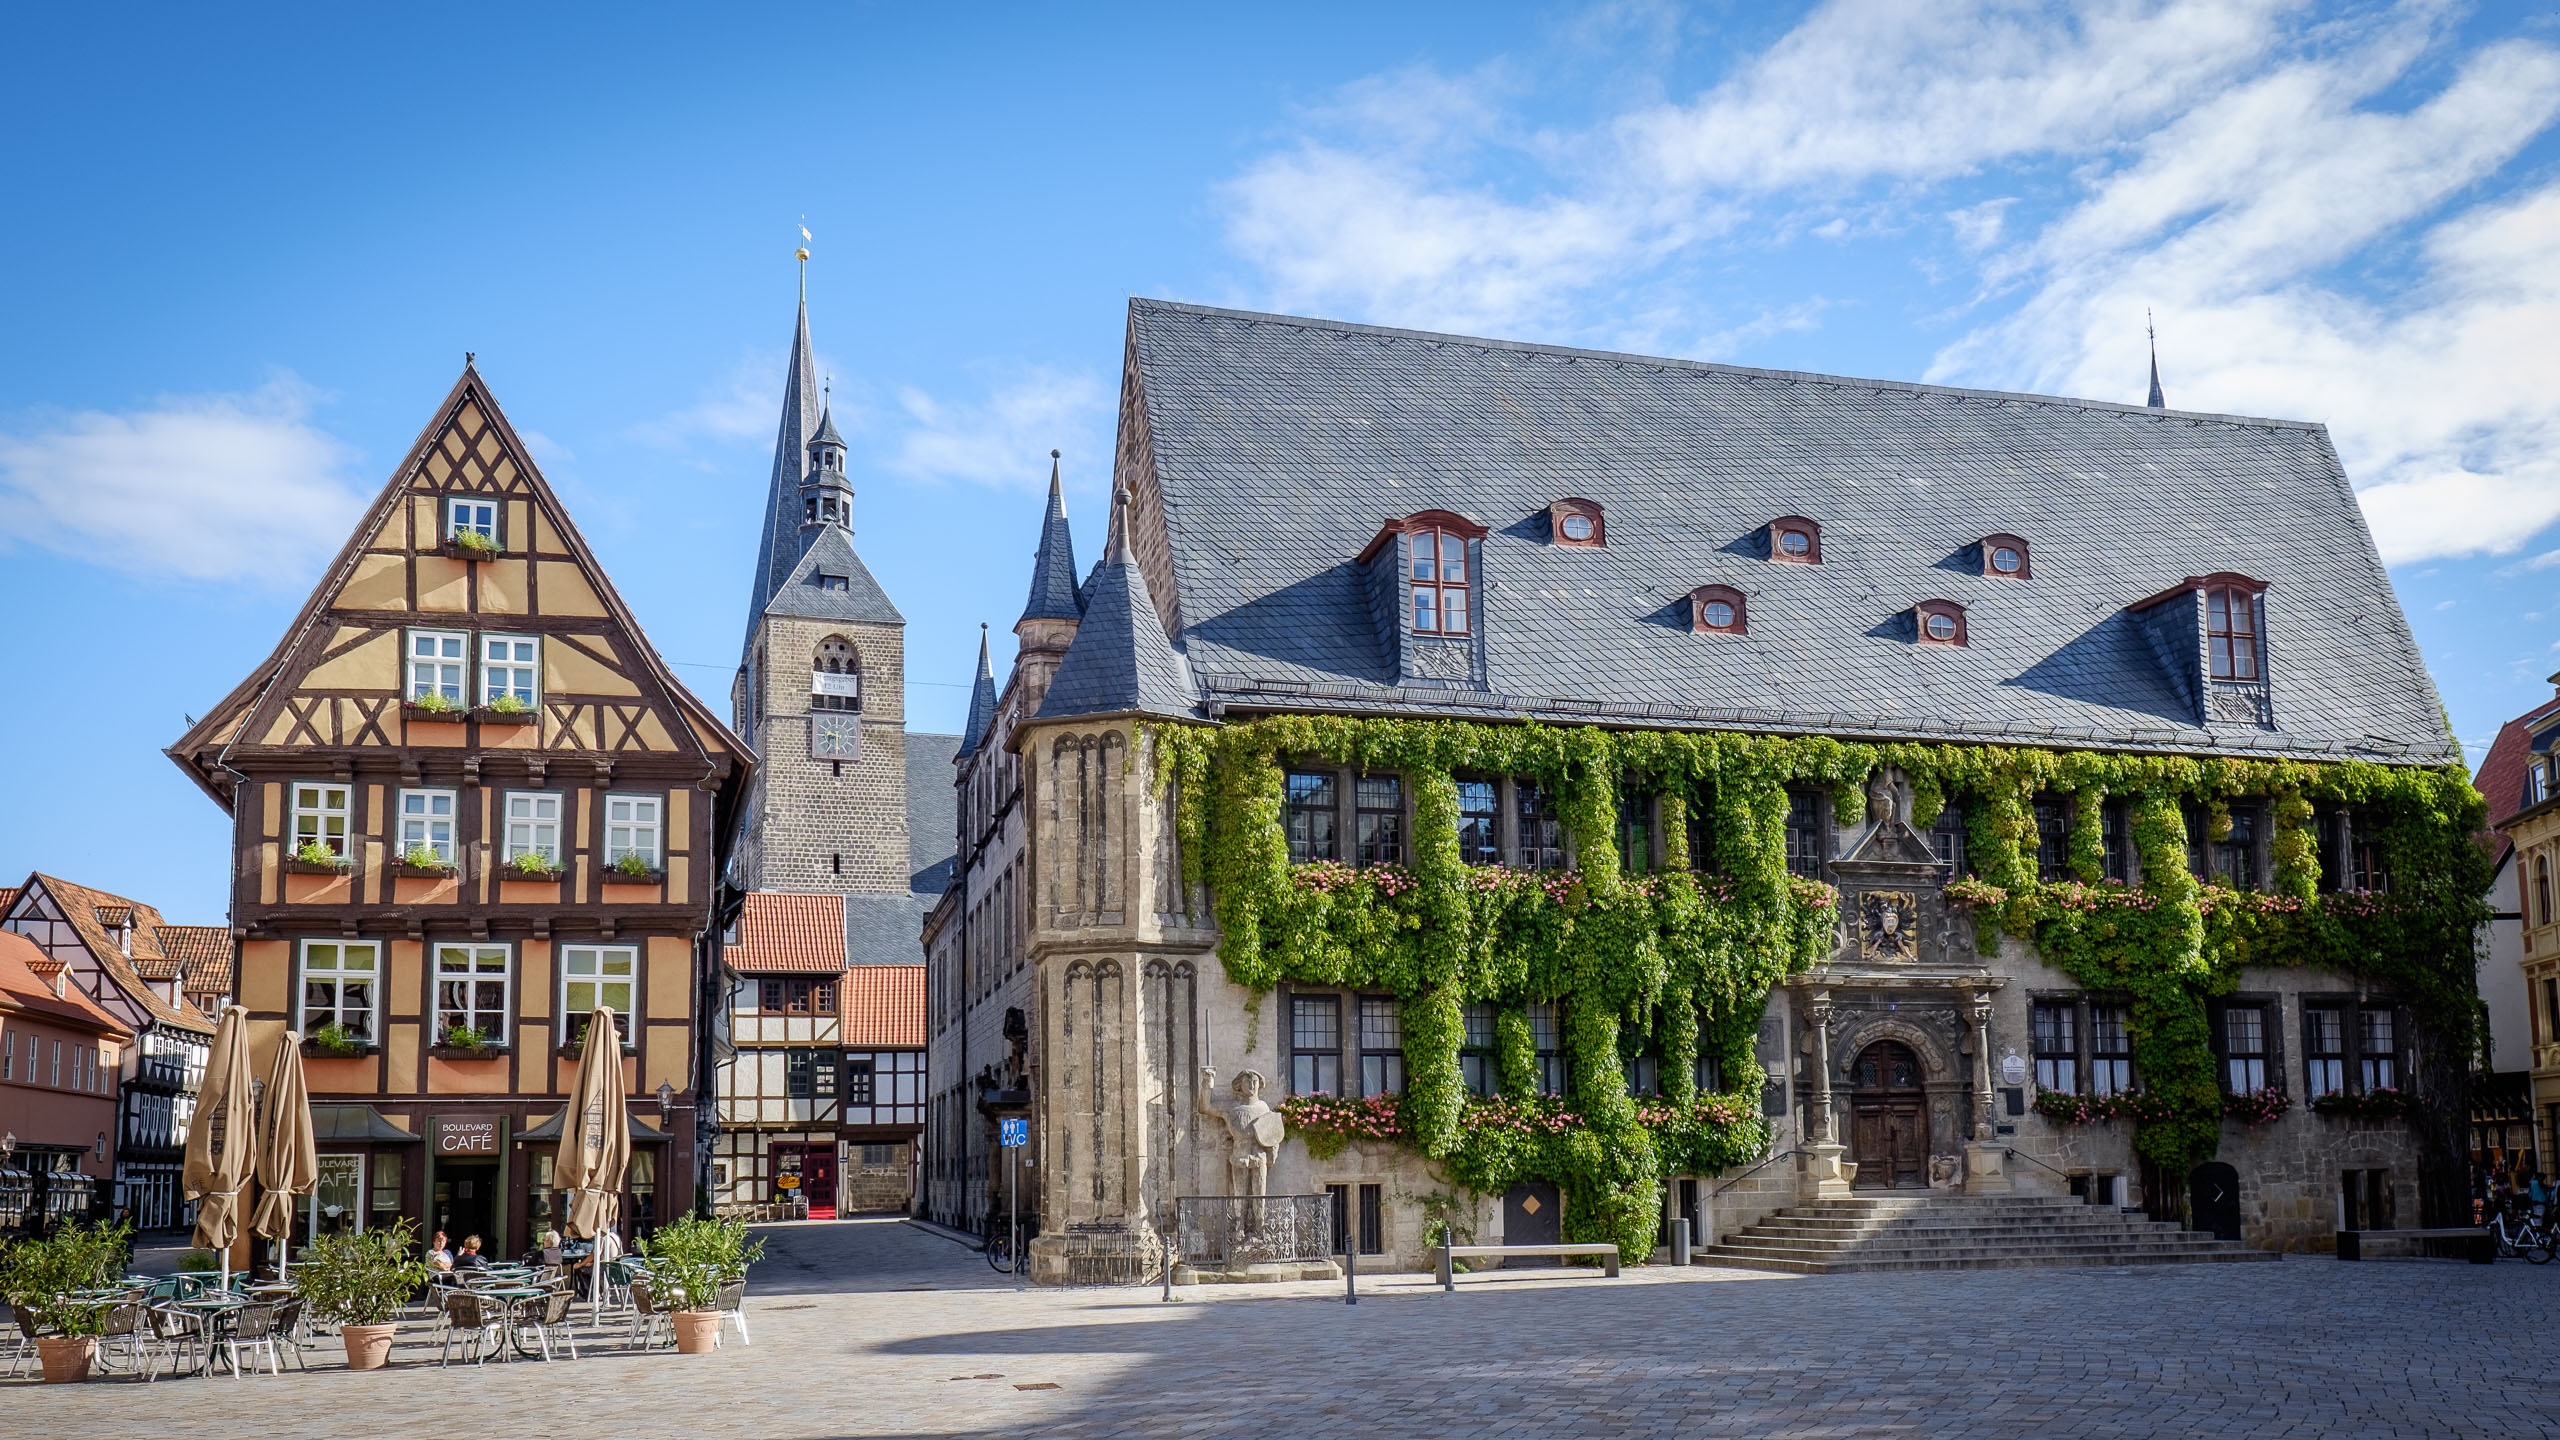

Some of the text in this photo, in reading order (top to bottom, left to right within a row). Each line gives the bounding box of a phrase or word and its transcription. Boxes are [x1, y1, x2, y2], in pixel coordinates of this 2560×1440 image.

[442, 1123, 493, 1132] BOULEVARD
[442, 1131, 493, 1151] CAFÉ
[1003, 1133, 1026, 1146] WC
[317, 1160, 360, 1168] ULEVARD
[318, 1168, 359, 1187] AFÉ
